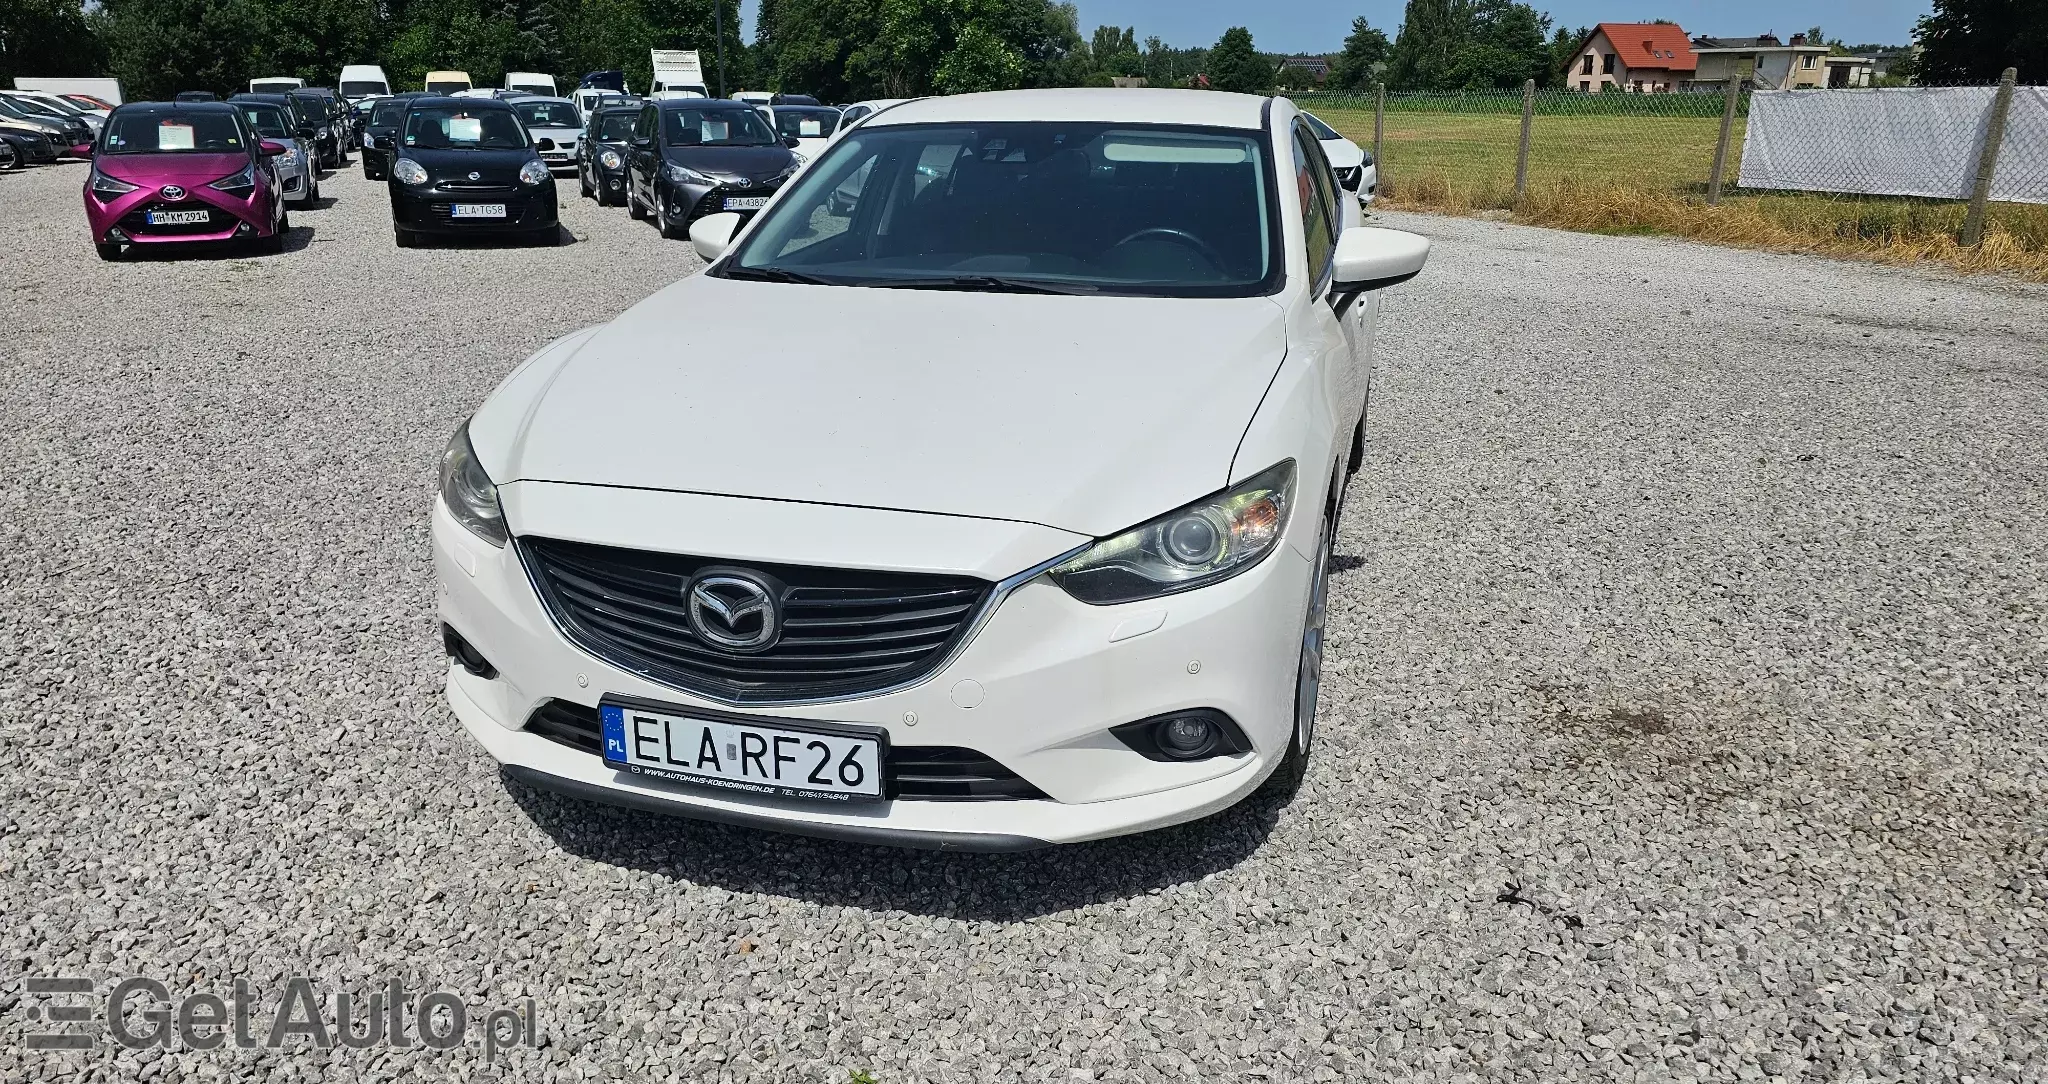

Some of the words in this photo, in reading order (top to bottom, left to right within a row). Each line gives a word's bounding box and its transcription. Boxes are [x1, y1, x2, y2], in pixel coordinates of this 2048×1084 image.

[153, 214, 165, 222] HH
[171, 213, 183, 221] KM
[185, 212, 207, 221] 2914
[458, 206, 476, 214] ELA
[480, 206, 503, 214] TG58
[608, 738, 624, 753] PL
[632, 715, 723, 773] ELA
[740, 731, 864, 787] RF26
[644, 768, 775, 793] WWW.AUTOHAUS-KOENDRINGEN.DE
